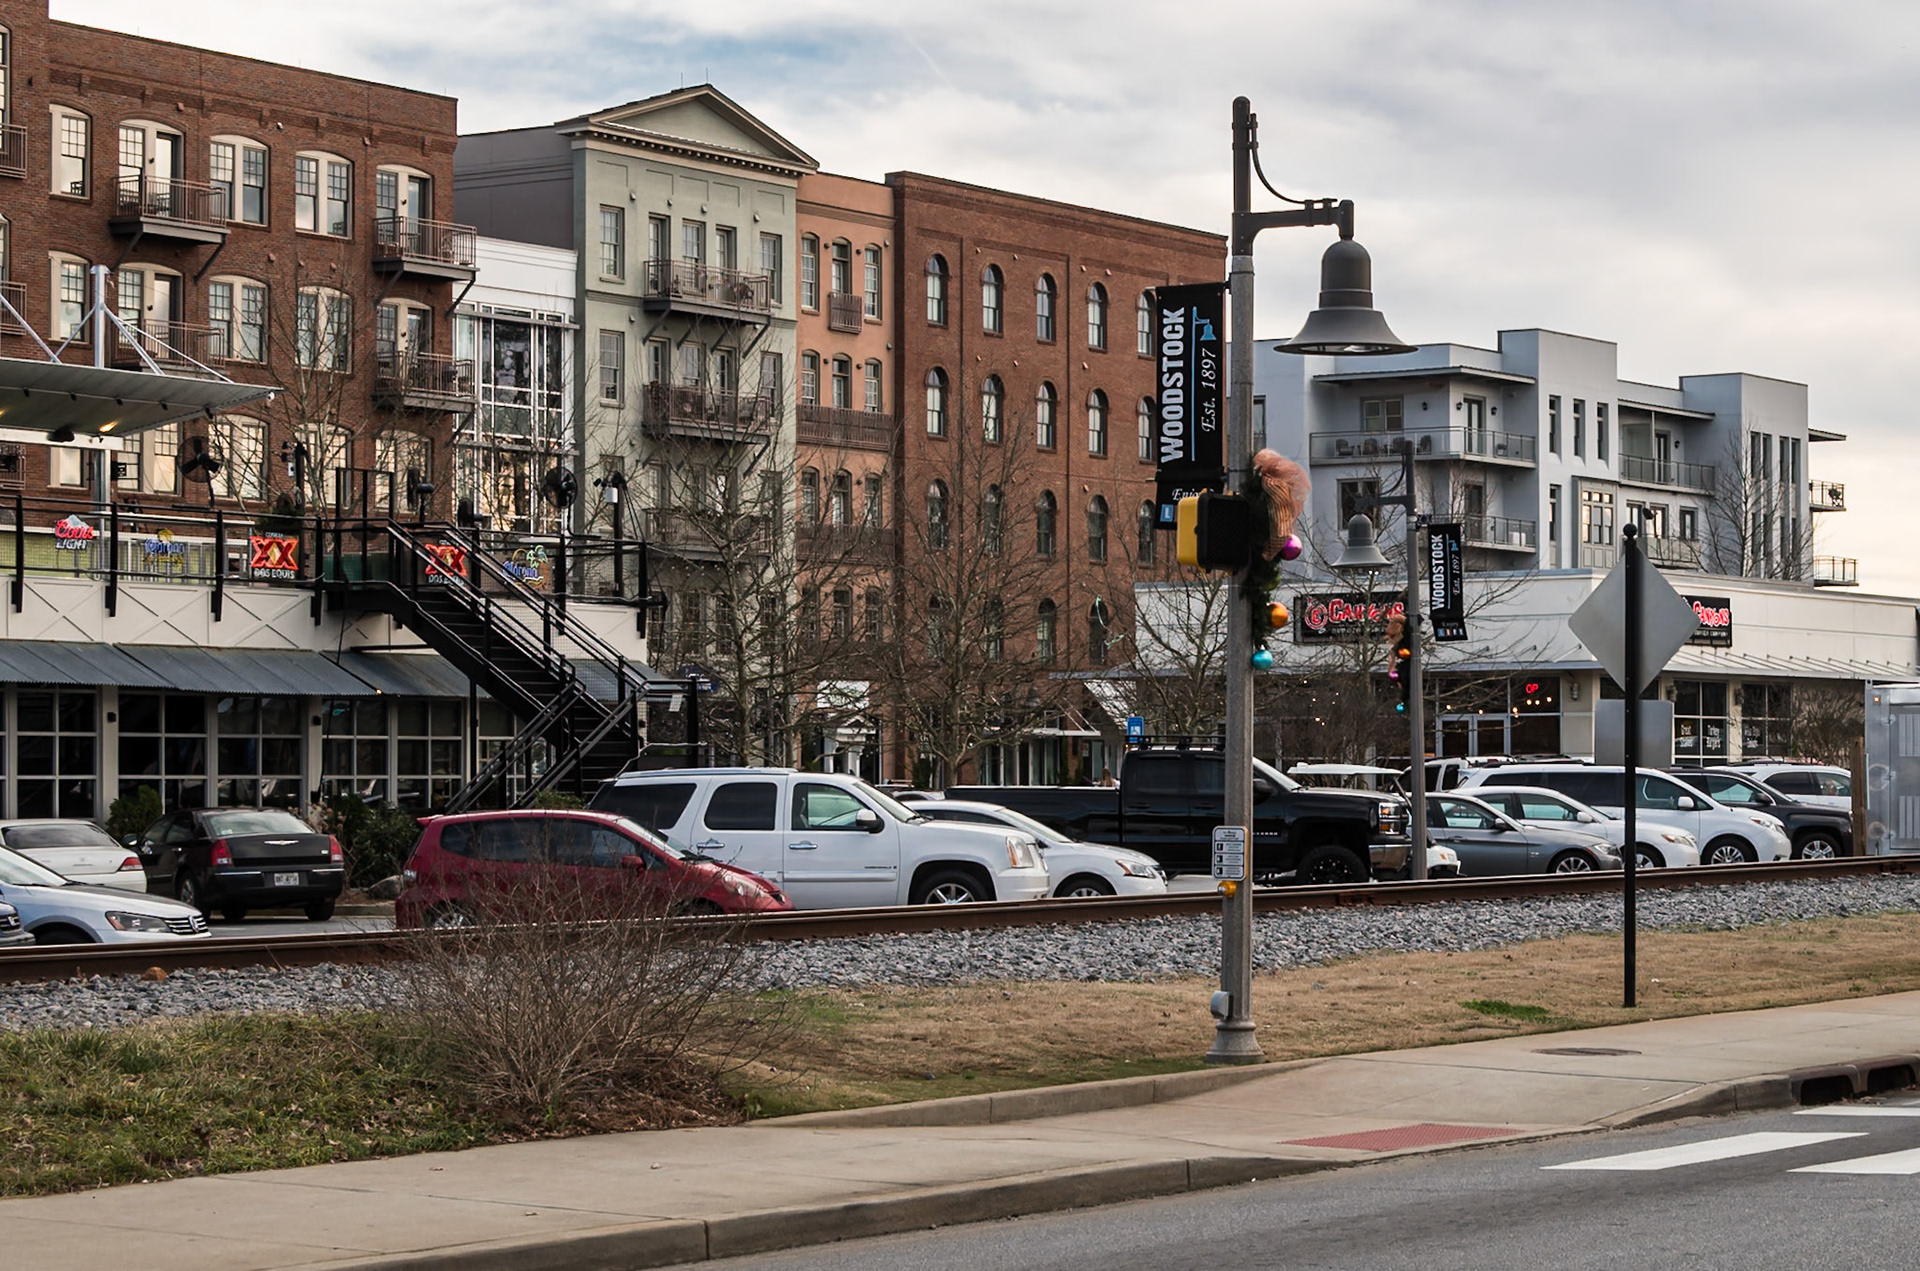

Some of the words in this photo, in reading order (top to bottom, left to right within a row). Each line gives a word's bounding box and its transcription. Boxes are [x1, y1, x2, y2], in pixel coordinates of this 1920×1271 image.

[1160, 306, 1185, 464] WOODSTOCK
[1201, 347, 1217, 390] 1897
[1201, 397, 1216, 433] Est.
[254, 568, 271, 578] DOS
[271, 568, 295, 579] EQUIS
[1431, 533, 1446, 611] WOODSTOCK
[1451, 554, 1460, 575] 1897
[1452, 577, 1461, 596] Est.
